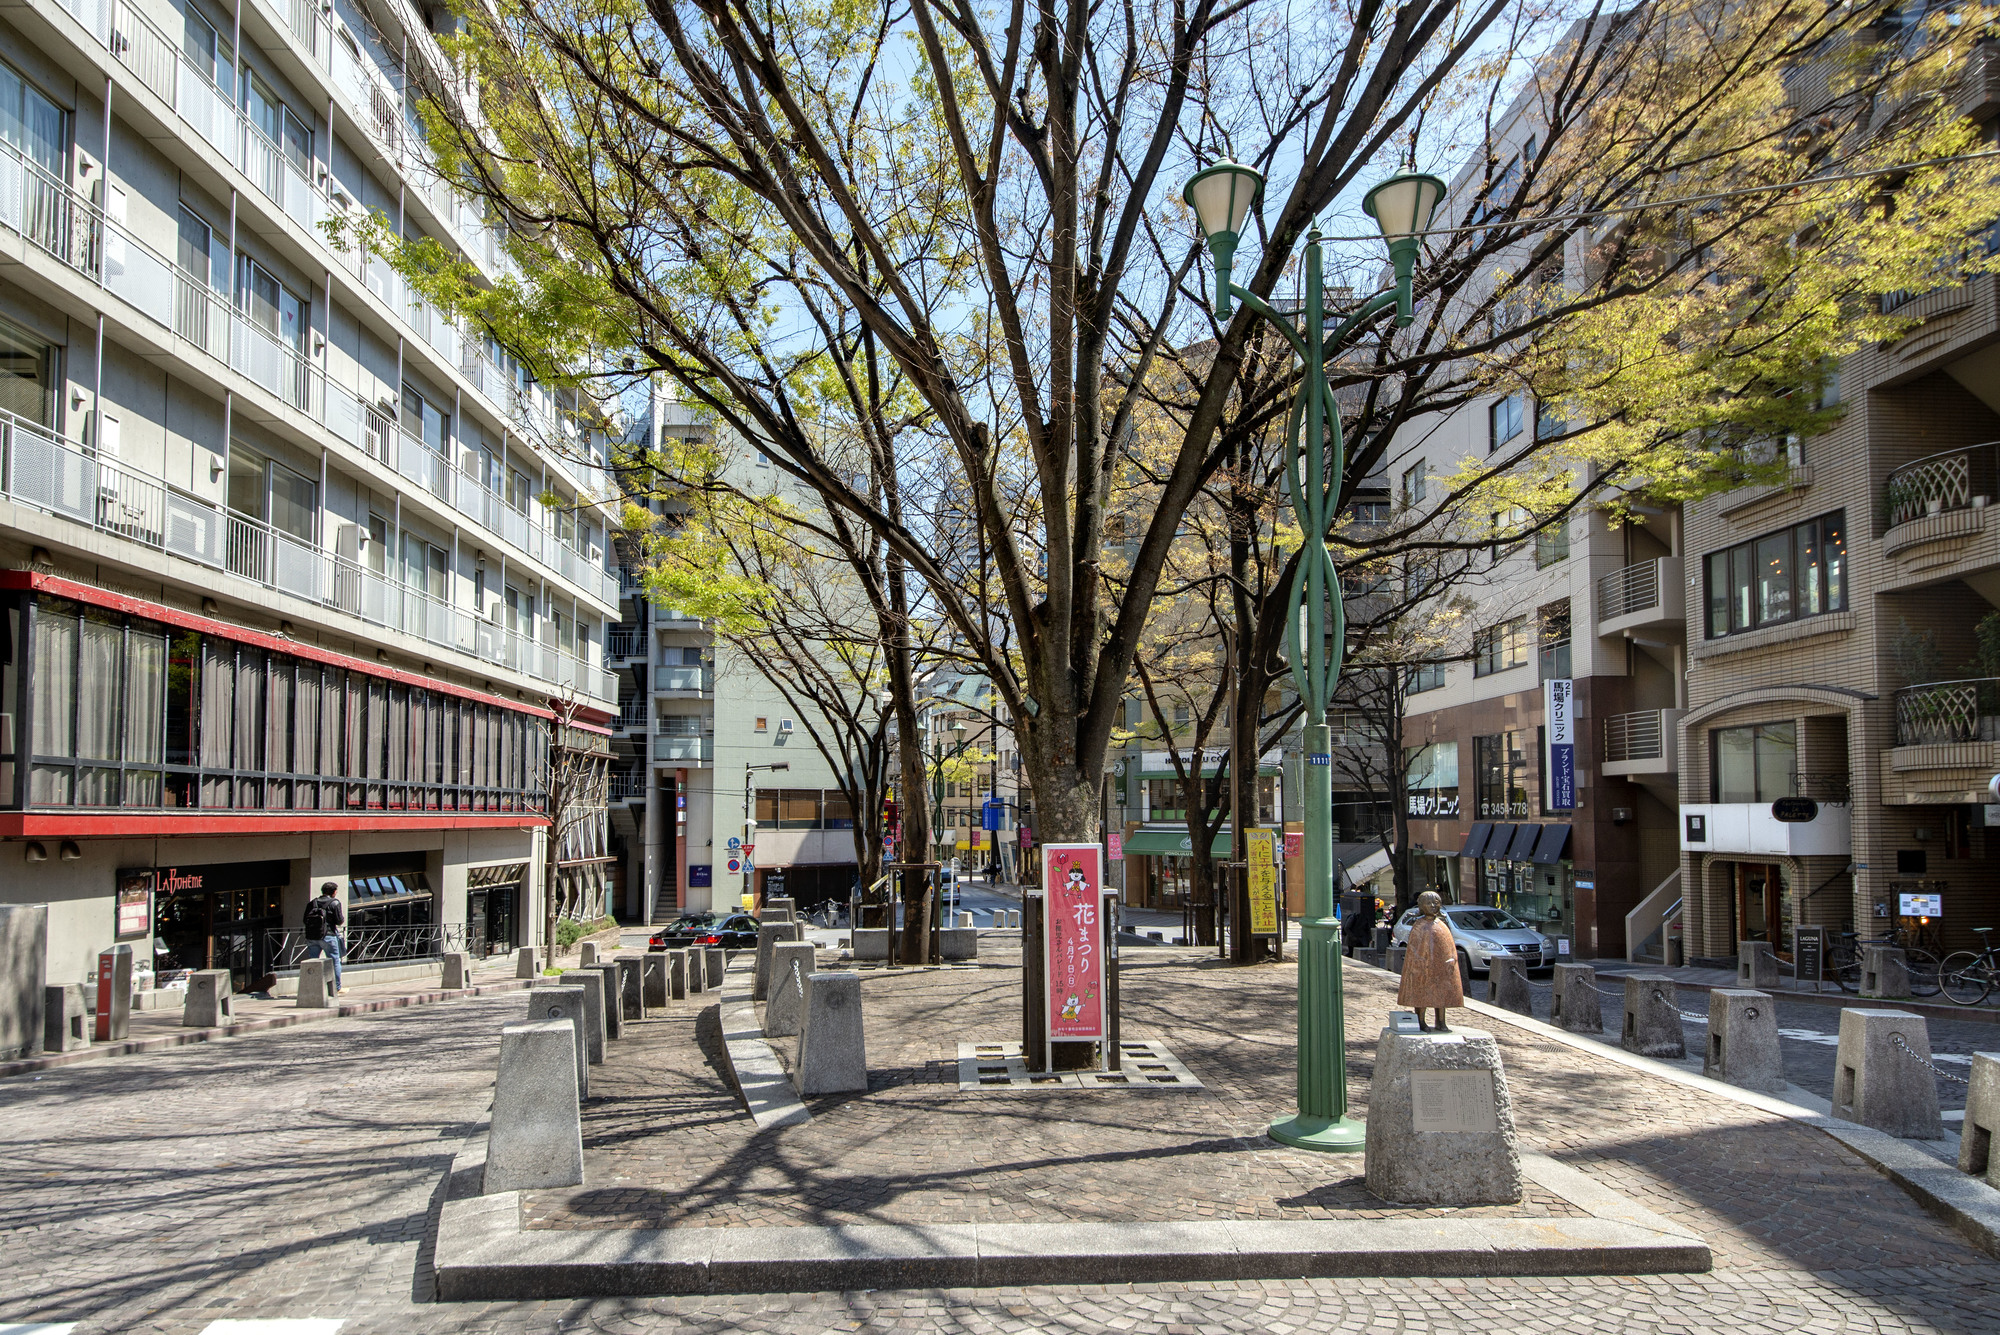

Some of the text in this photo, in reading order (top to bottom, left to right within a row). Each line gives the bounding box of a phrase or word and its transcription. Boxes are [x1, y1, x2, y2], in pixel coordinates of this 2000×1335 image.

[1553, 682, 1565, 741] 馬場クリニック
[1565, 683, 1571, 698] 2F
[1312, 757, 1329, 765] 1111
[1561, 748, 1571, 806] ブランド宝石買取
[1258, 840, 1275, 927] ハトにエサを与えること禁止
[1073, 903, 1095, 973] 花まつり
